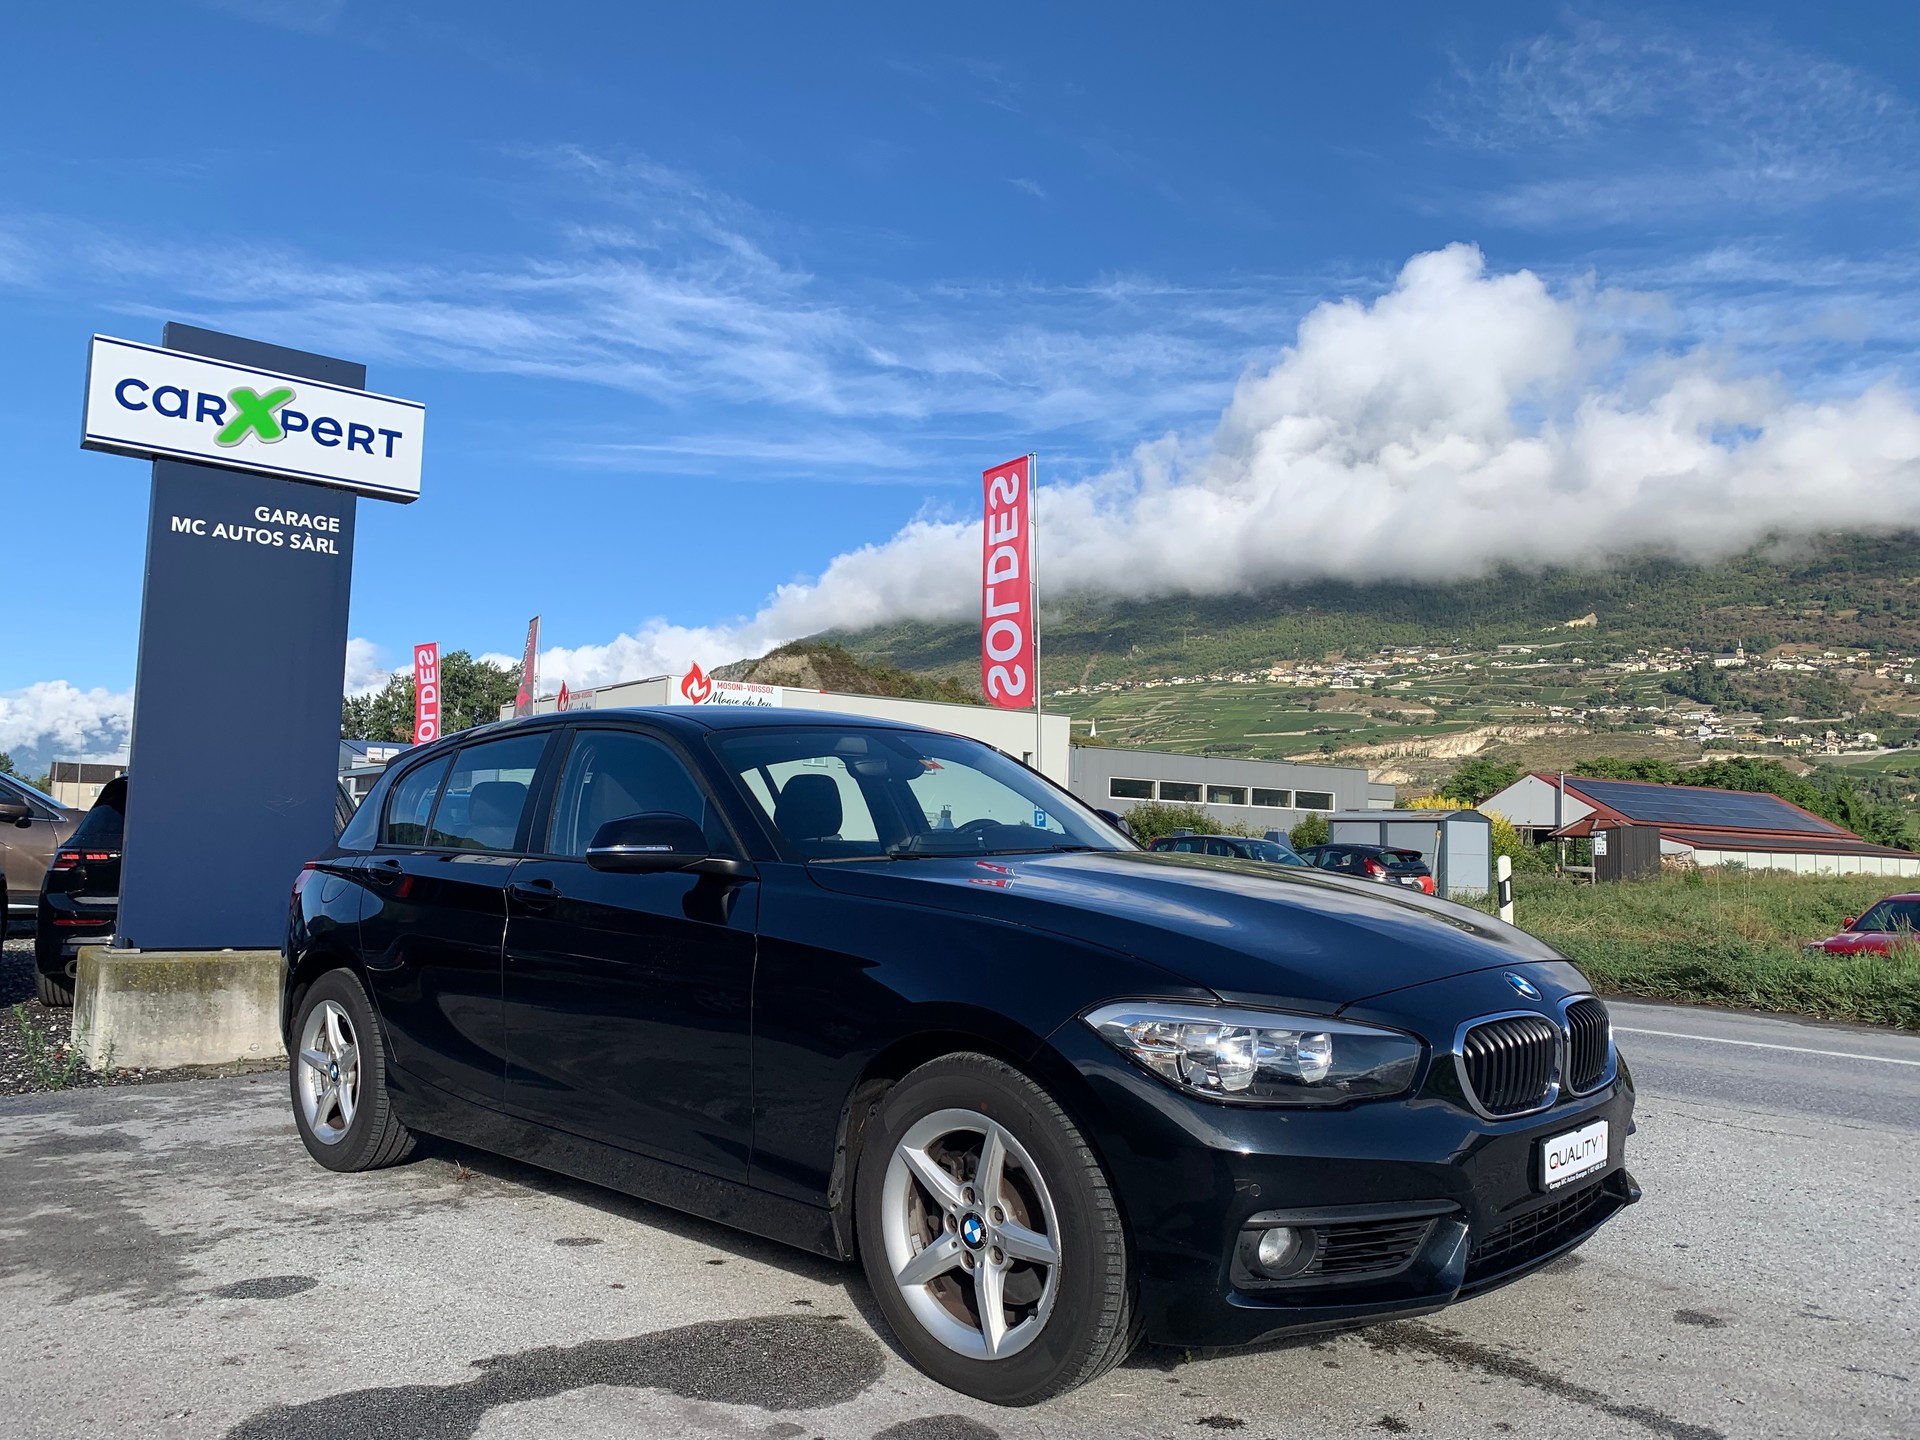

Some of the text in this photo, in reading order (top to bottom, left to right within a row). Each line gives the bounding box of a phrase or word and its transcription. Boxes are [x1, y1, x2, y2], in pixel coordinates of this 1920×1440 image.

[254, 506, 340, 532] GARAGE
[171, 516, 339, 555] MC AUTOS SÀRL
[1036, 812, 1044, 825] P
